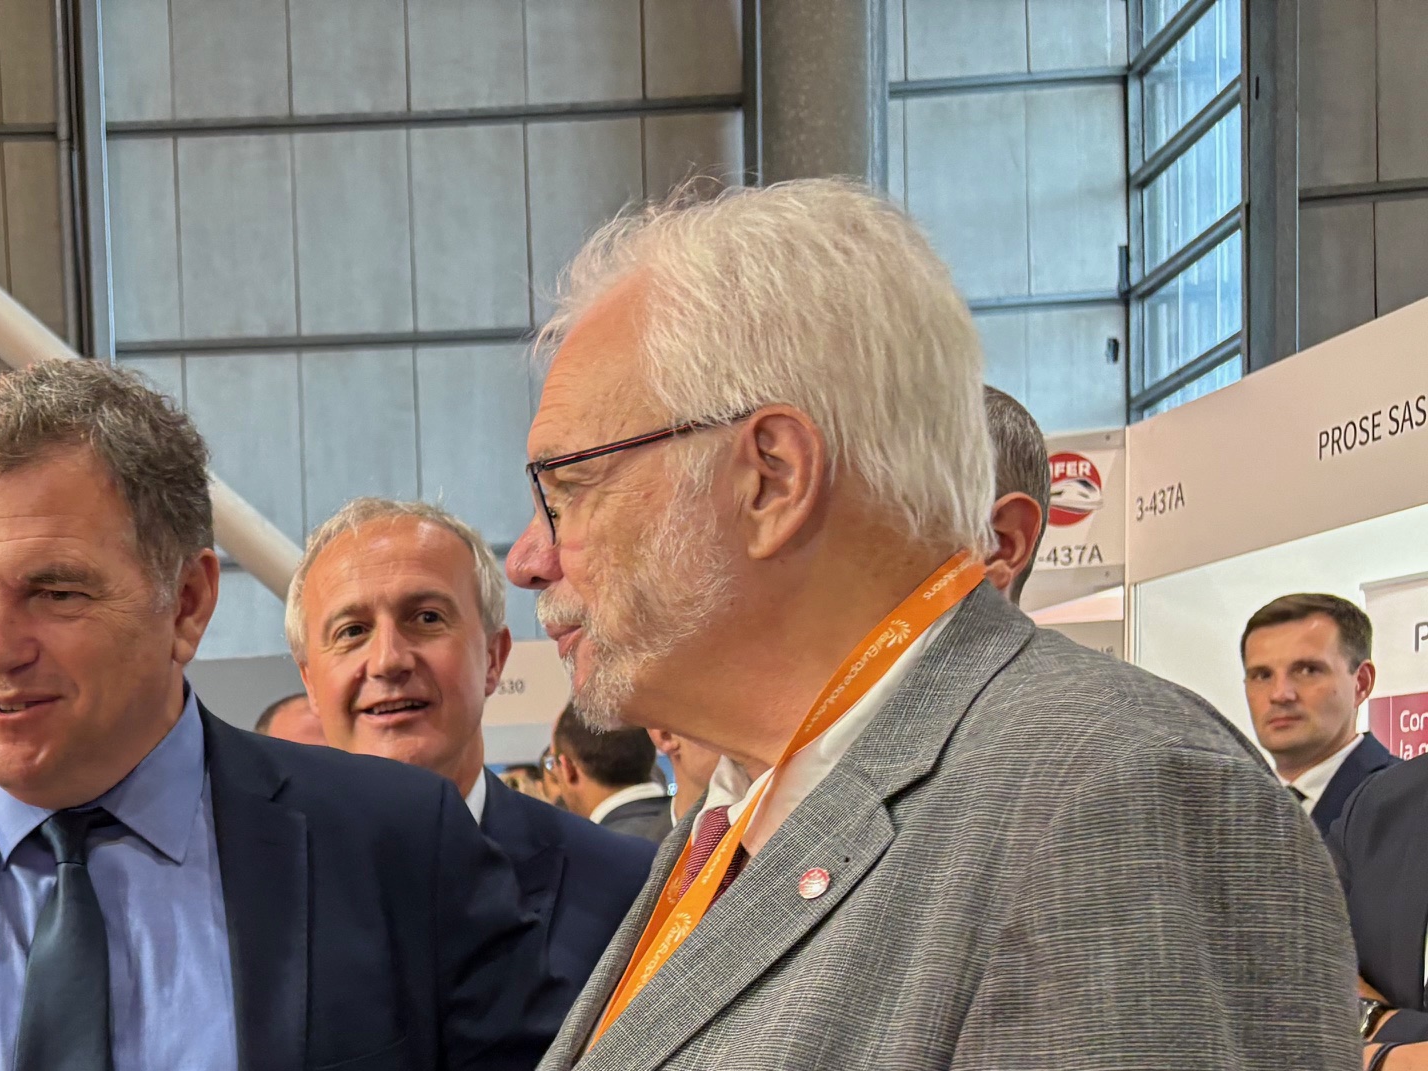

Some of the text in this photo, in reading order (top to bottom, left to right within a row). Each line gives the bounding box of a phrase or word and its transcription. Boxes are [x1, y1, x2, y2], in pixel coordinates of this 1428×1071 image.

[1318, 394, 1427, 461] PROSE SAS
[1136, 482, 1186, 522] 3-437A
[1038, 544, 1104, 567] -437A
